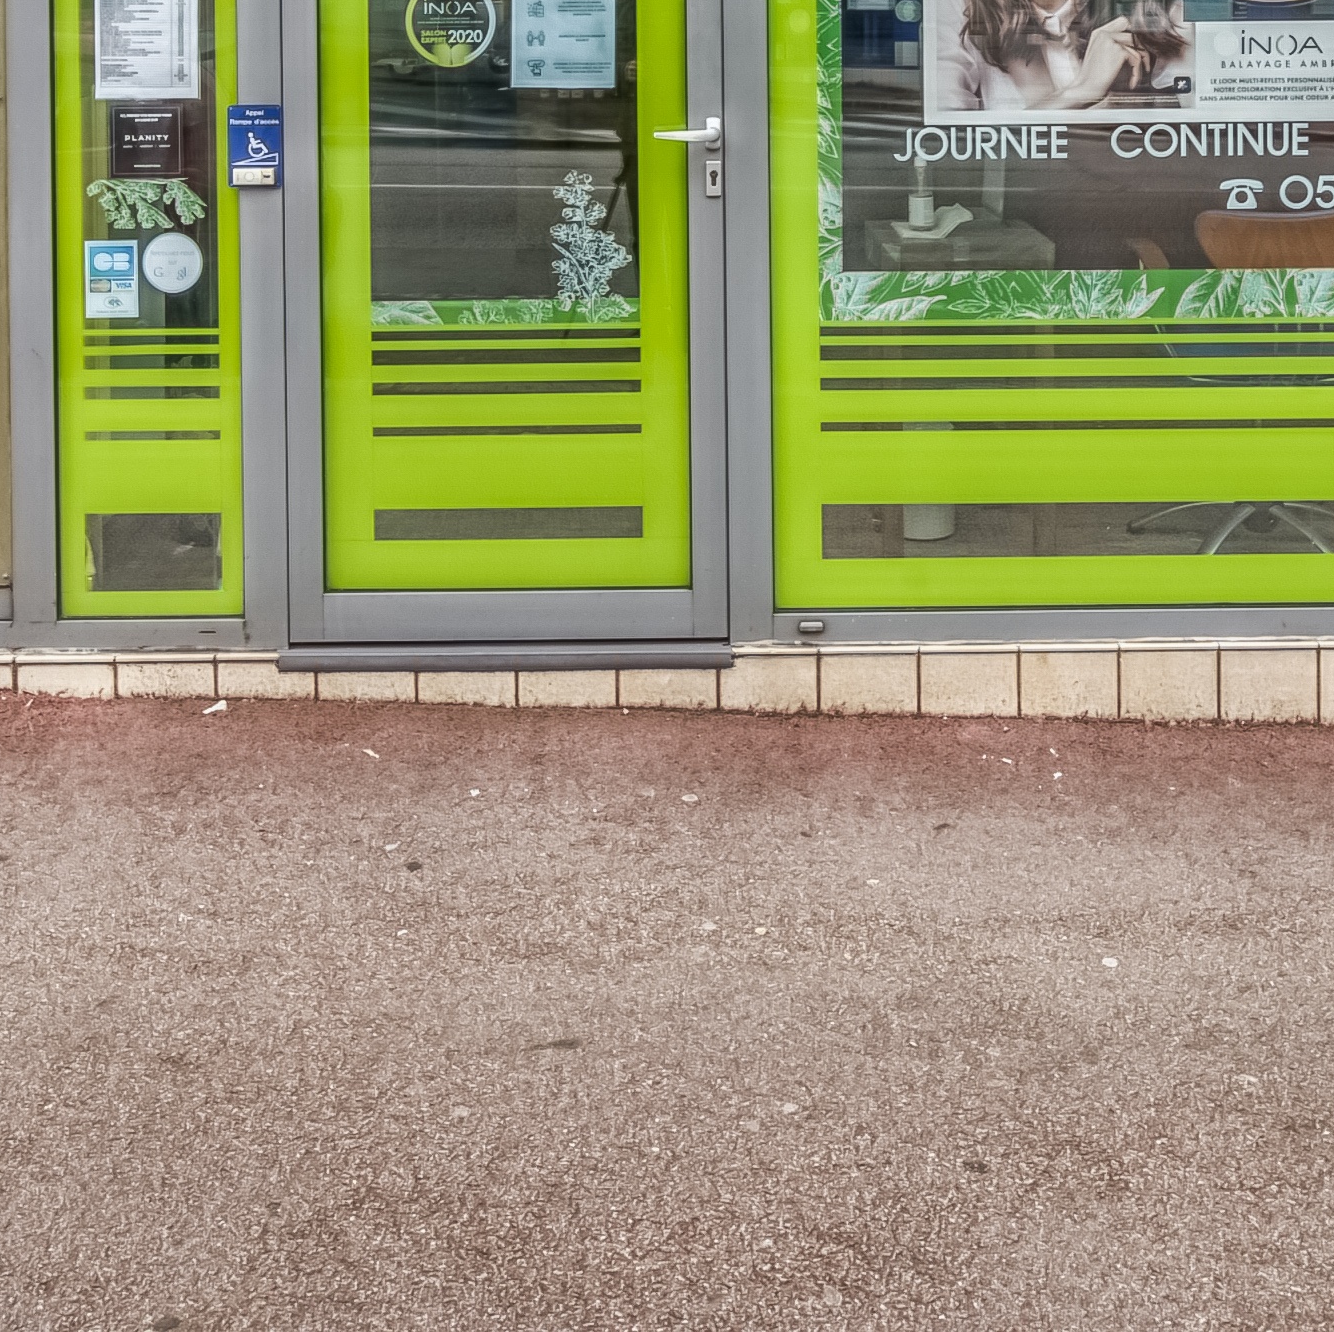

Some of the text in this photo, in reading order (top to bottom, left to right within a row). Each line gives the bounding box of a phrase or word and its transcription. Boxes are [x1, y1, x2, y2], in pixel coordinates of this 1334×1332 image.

[447, 29, 484, 44] 2020
[1221, 59, 1291, 69] BALAYAGE
[893, 122, 1309, 162] JOURNEE CONTINUE
